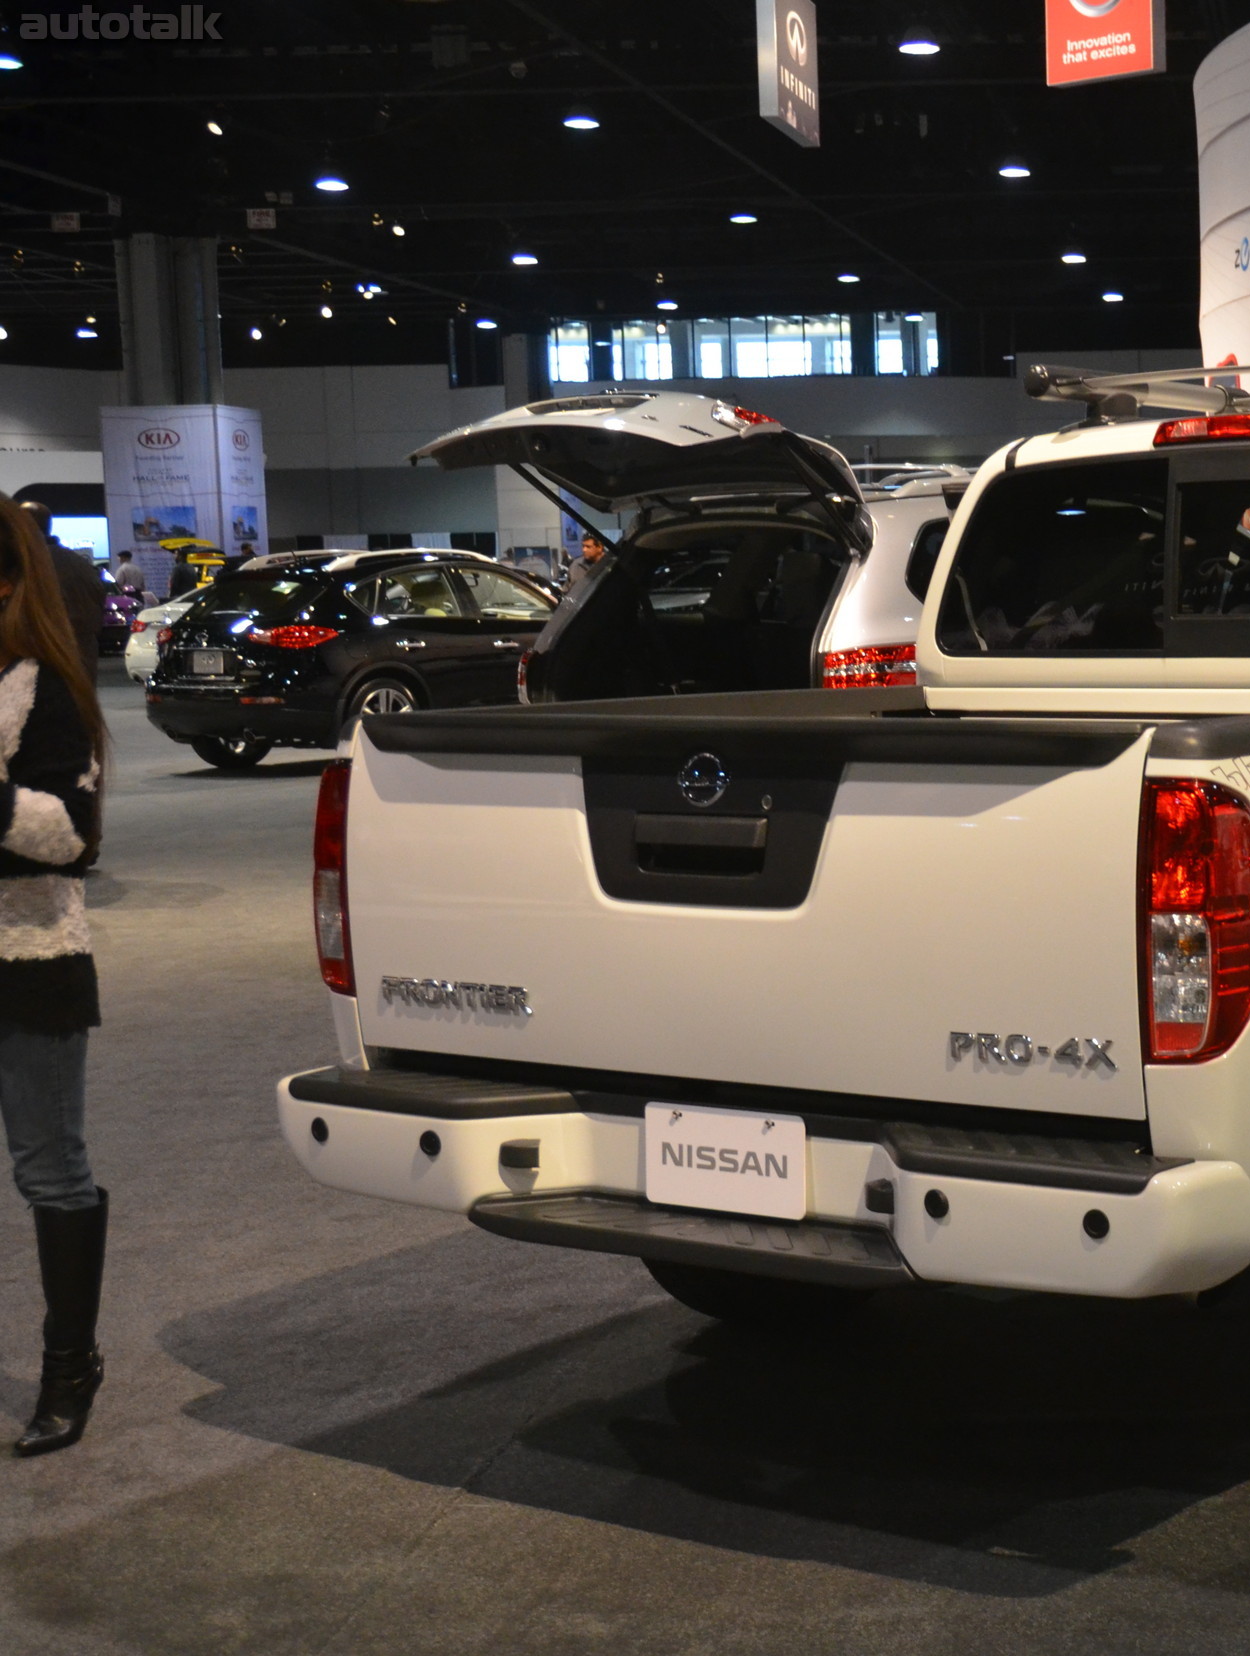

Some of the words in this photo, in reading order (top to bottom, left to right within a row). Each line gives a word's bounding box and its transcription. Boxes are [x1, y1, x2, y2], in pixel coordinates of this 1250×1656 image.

[1062, 50, 1087, 65] that
[1090, 44, 1136, 60] excites
[1067, 32, 1132, 51] Innovation
[780, 65, 816, 111] INFINITI
[381, 975, 534, 1017] FRONTIER
[949, 1031, 1119, 1072] PRO-4X
[661, 1141, 788, 1180] NISSAN
